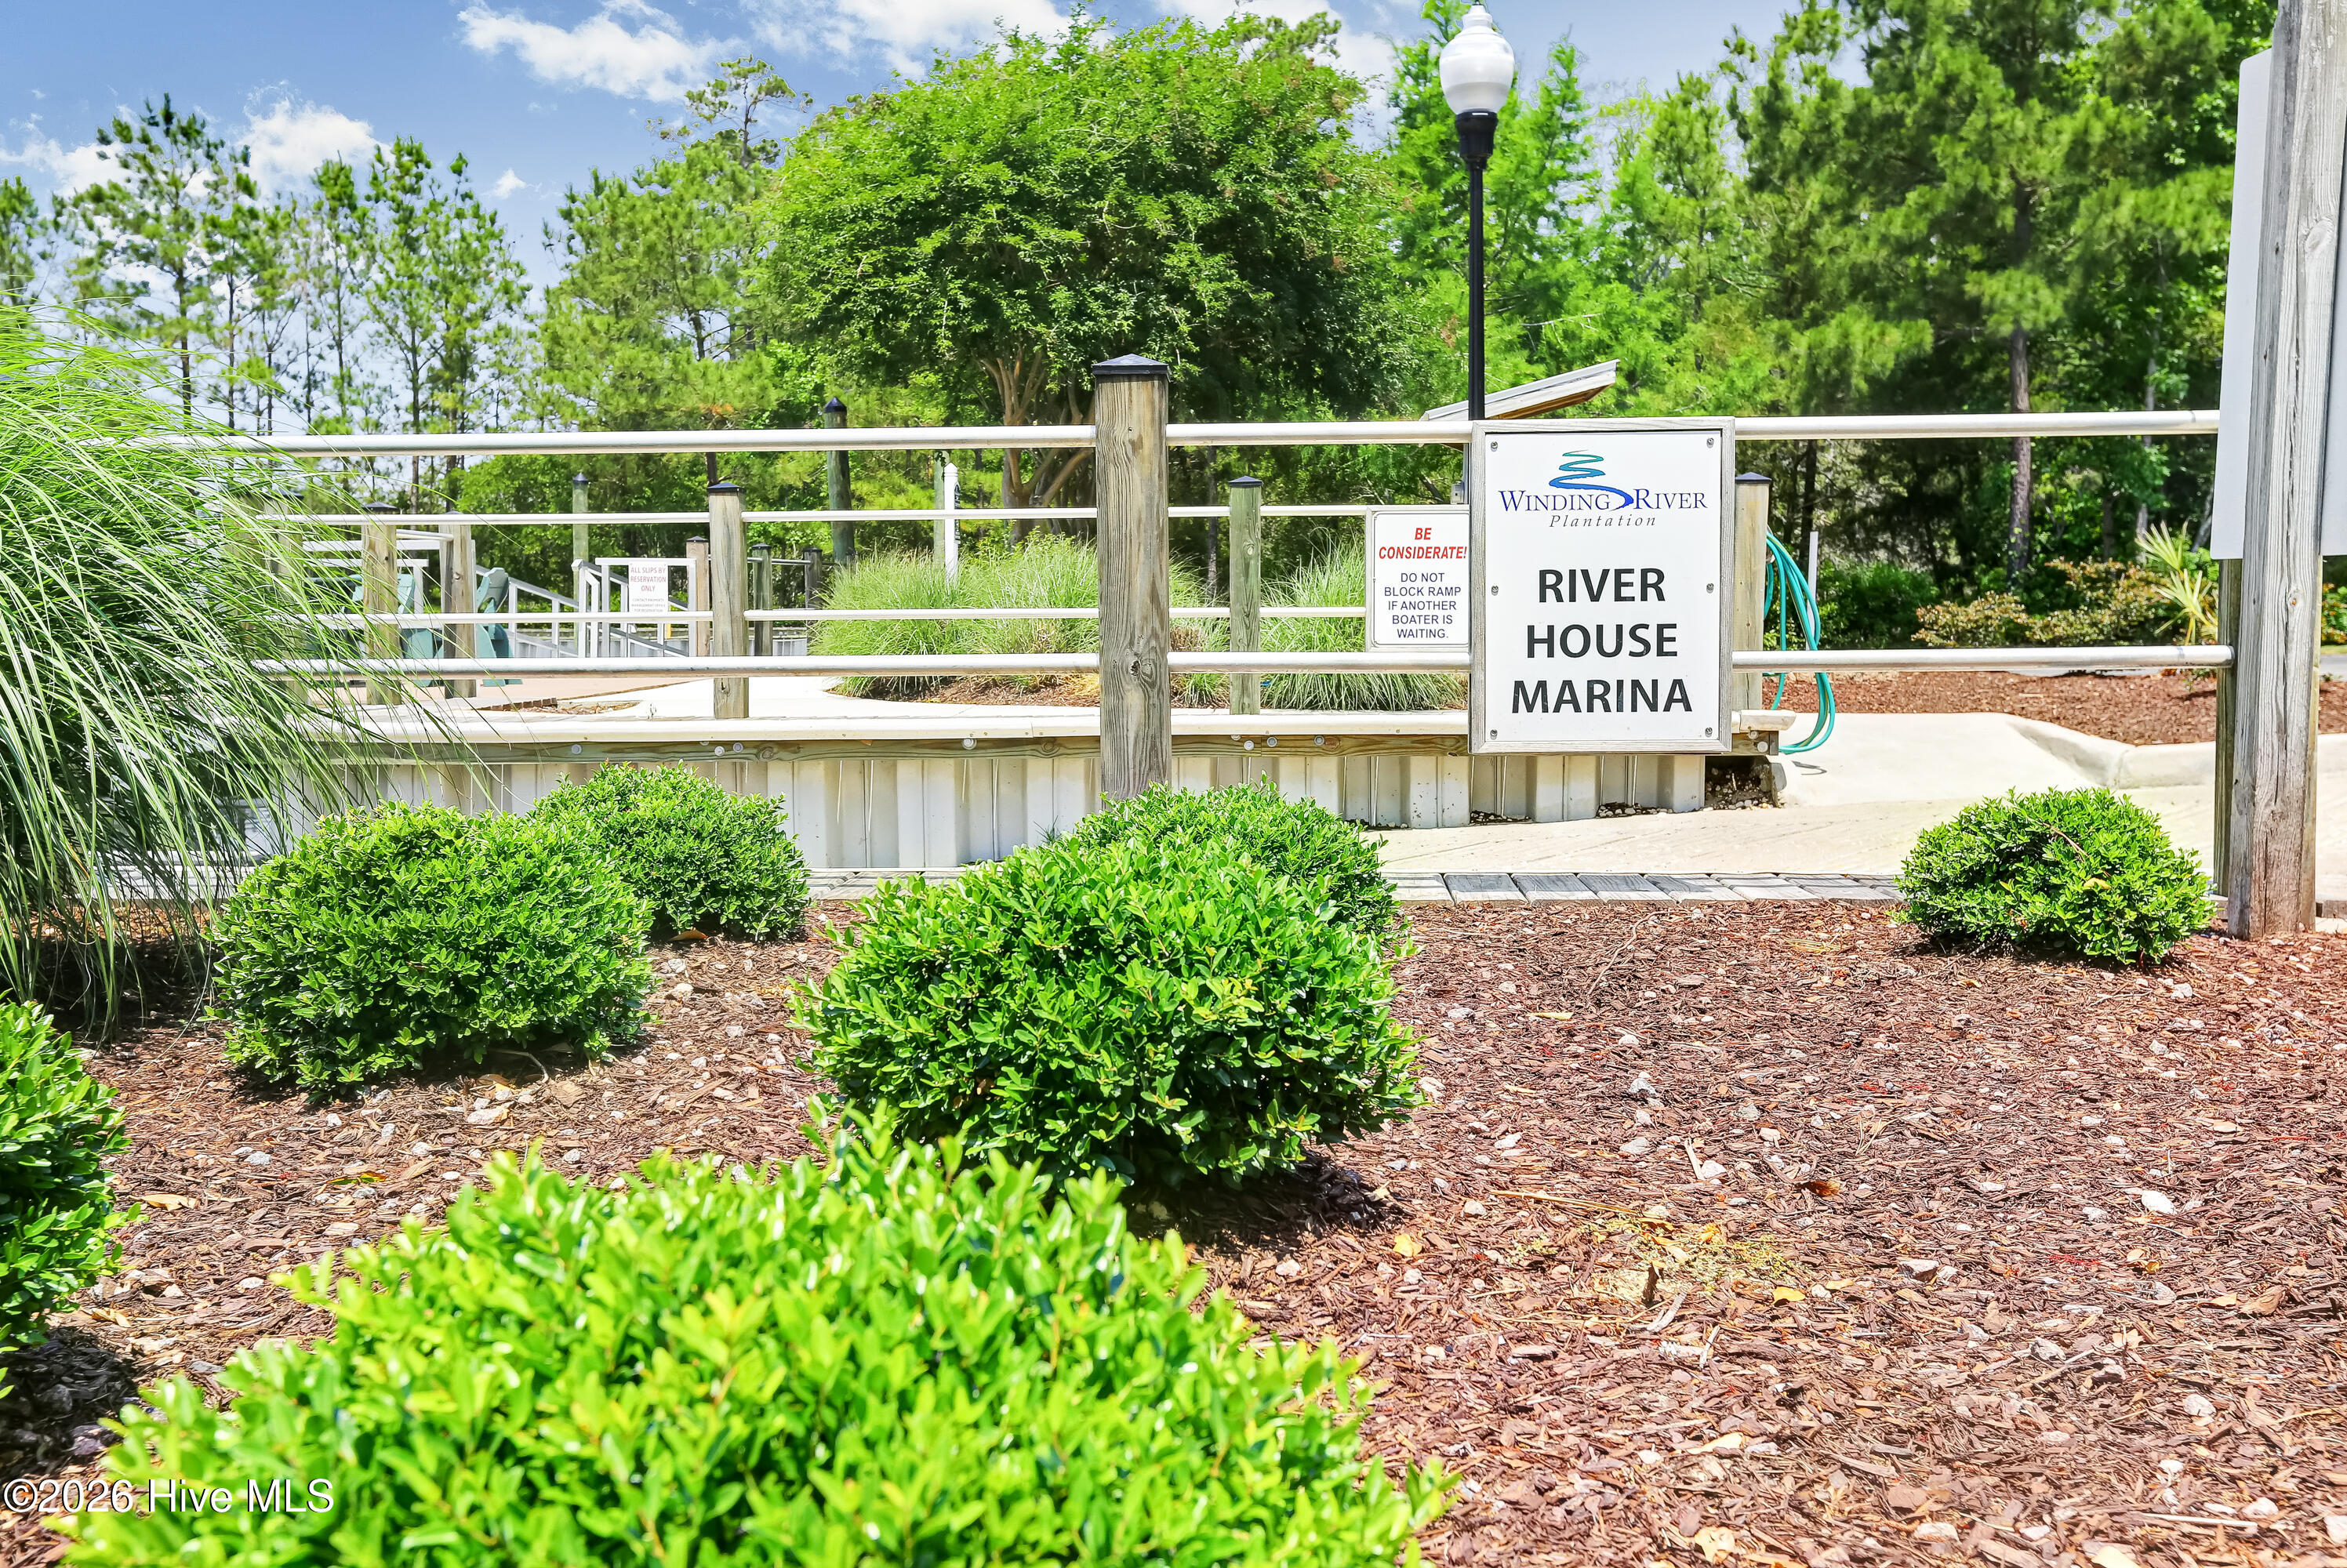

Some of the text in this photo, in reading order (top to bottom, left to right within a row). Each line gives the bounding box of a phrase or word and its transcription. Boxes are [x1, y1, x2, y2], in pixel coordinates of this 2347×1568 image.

[1498, 488, 1708, 511] WINDING RIVER
[1549, 514, 1656, 528] Plantation
[1415, 528, 1432, 540] BE
[1379, 546, 1467, 559] CONSIDERATE!
[1401, 573, 1444, 582] DO NOT
[1384, 586, 1462, 596] BLOCK RAMP
[1539, 568, 1666, 603] RIVER
[1388, 601, 1457, 610] IF ANOTHER
[1392, 615, 1453, 624] BOATER IS
[1397, 629, 1448, 638] WAITING.
[1527, 623, 1678, 658] HOUSE
[1512, 679, 1692, 713] MARINA
